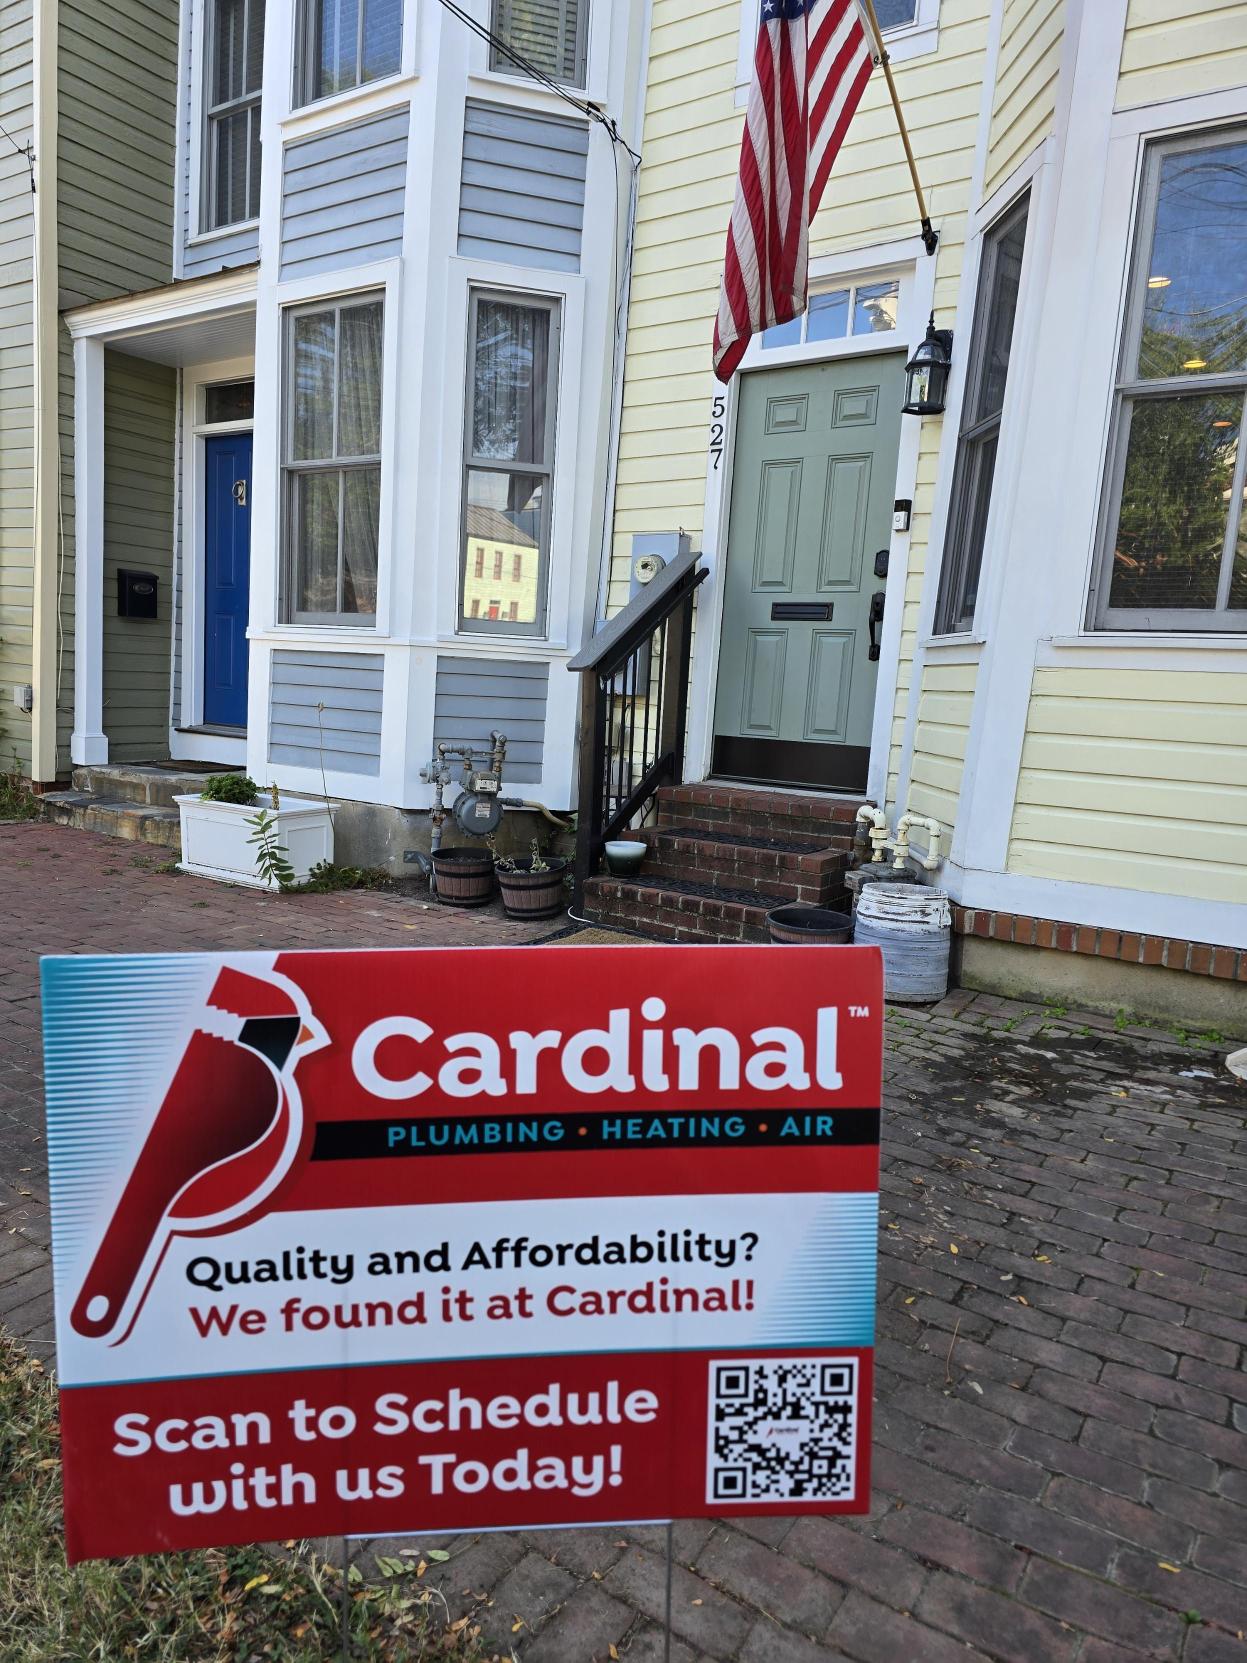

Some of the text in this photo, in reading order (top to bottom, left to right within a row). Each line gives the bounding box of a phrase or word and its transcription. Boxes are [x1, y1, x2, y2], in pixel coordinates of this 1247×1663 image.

[709, 396, 725, 470] 527
[351, 996, 843, 1100] Cardinal
[388, 1115, 834, 1147] PLUMBING HEATING AIR
[185, 1229, 759, 1292] Quality and Affordability?
[188, 1276, 755, 1338] We found it at Cardinal!
[113, 1380, 660, 1456] Scan to Schedule
[169, 1445, 622, 1516] with us Today!
